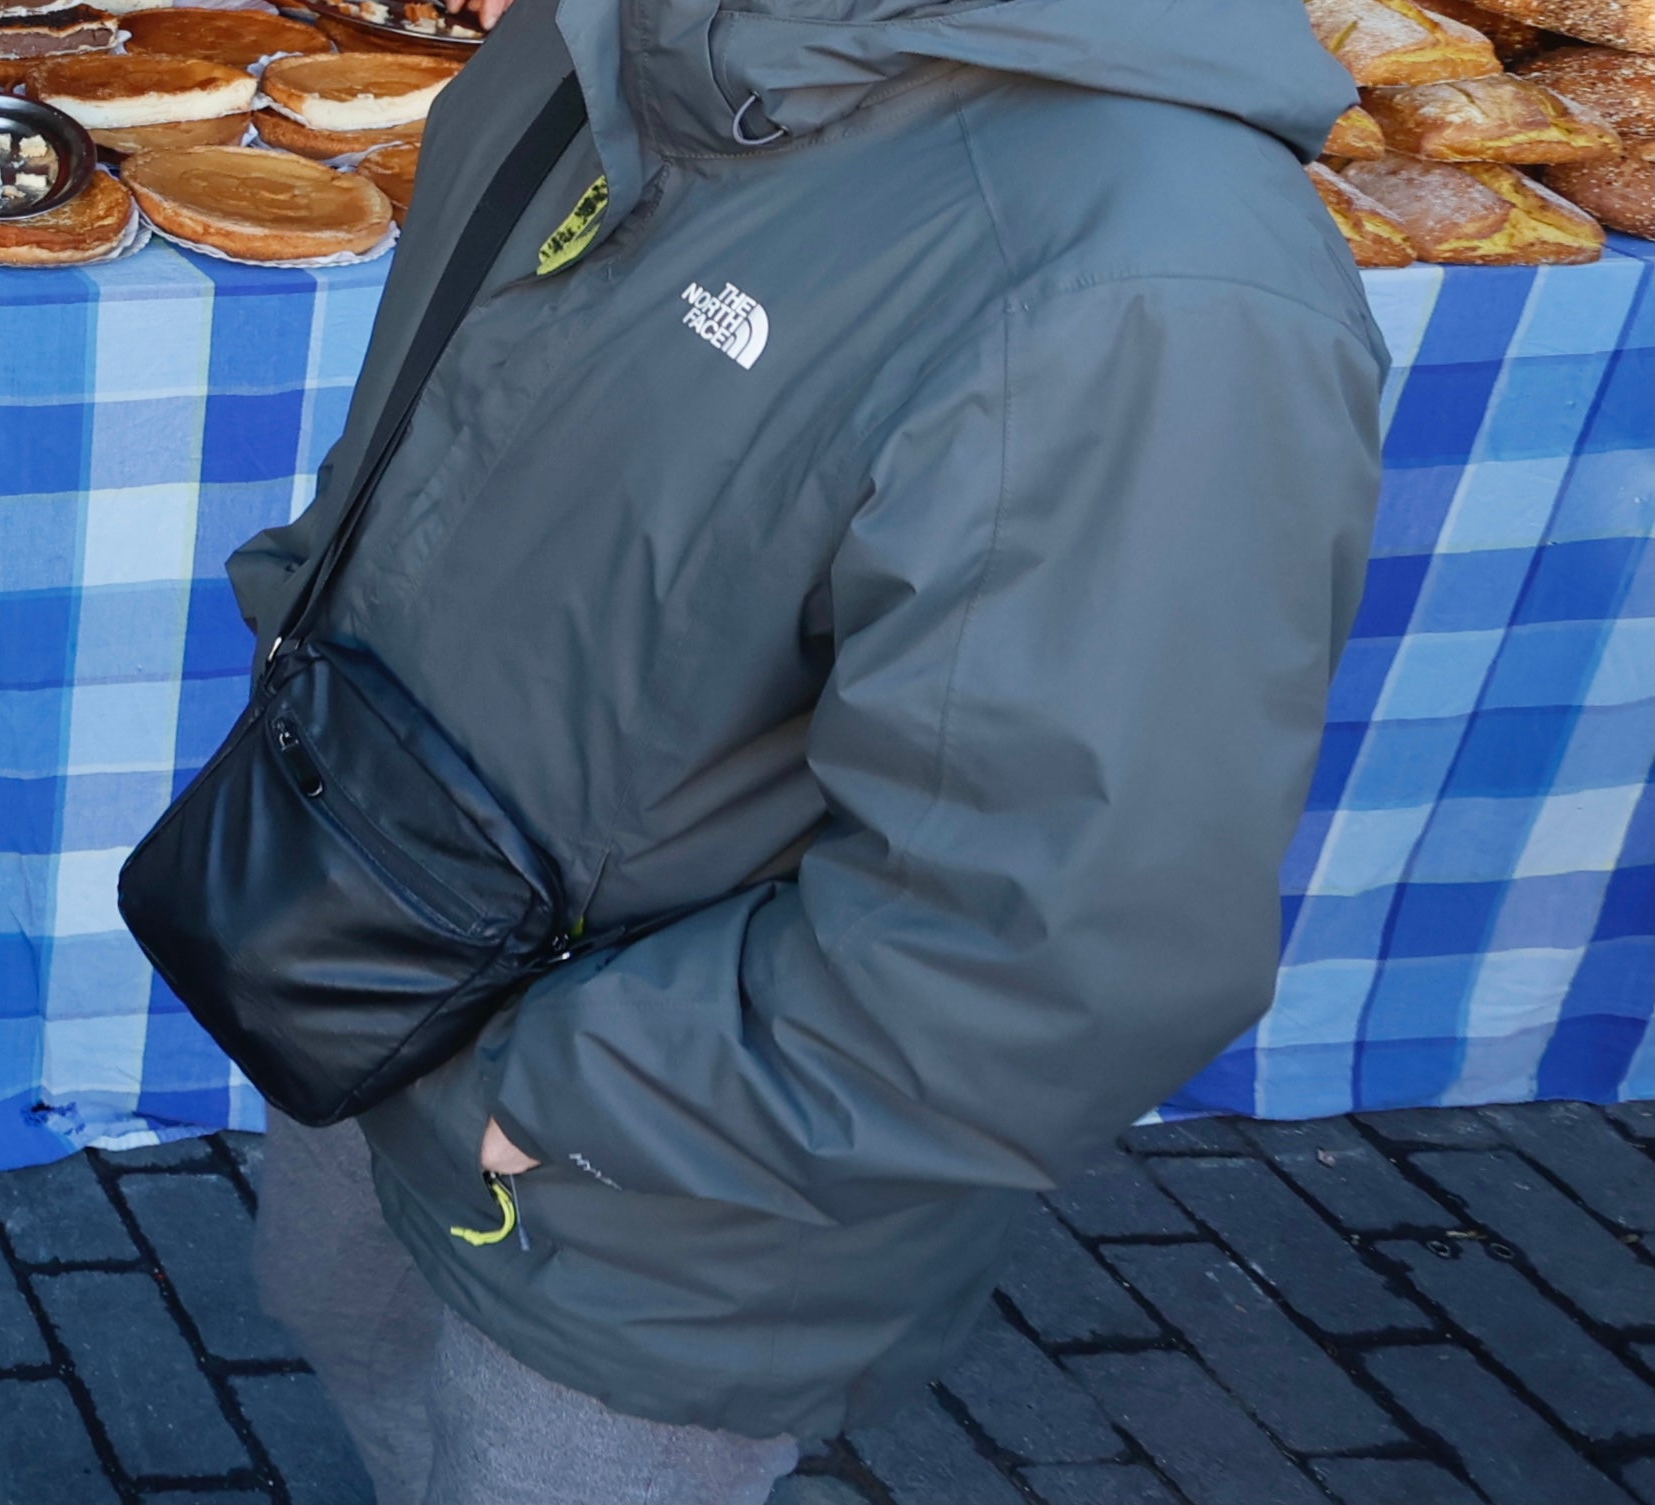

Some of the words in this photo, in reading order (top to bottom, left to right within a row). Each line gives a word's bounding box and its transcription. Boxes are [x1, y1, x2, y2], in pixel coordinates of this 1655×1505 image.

[681, 282, 745, 334] NORTH
[718, 282, 758, 318] THE
[682, 307, 732, 349] FACE
